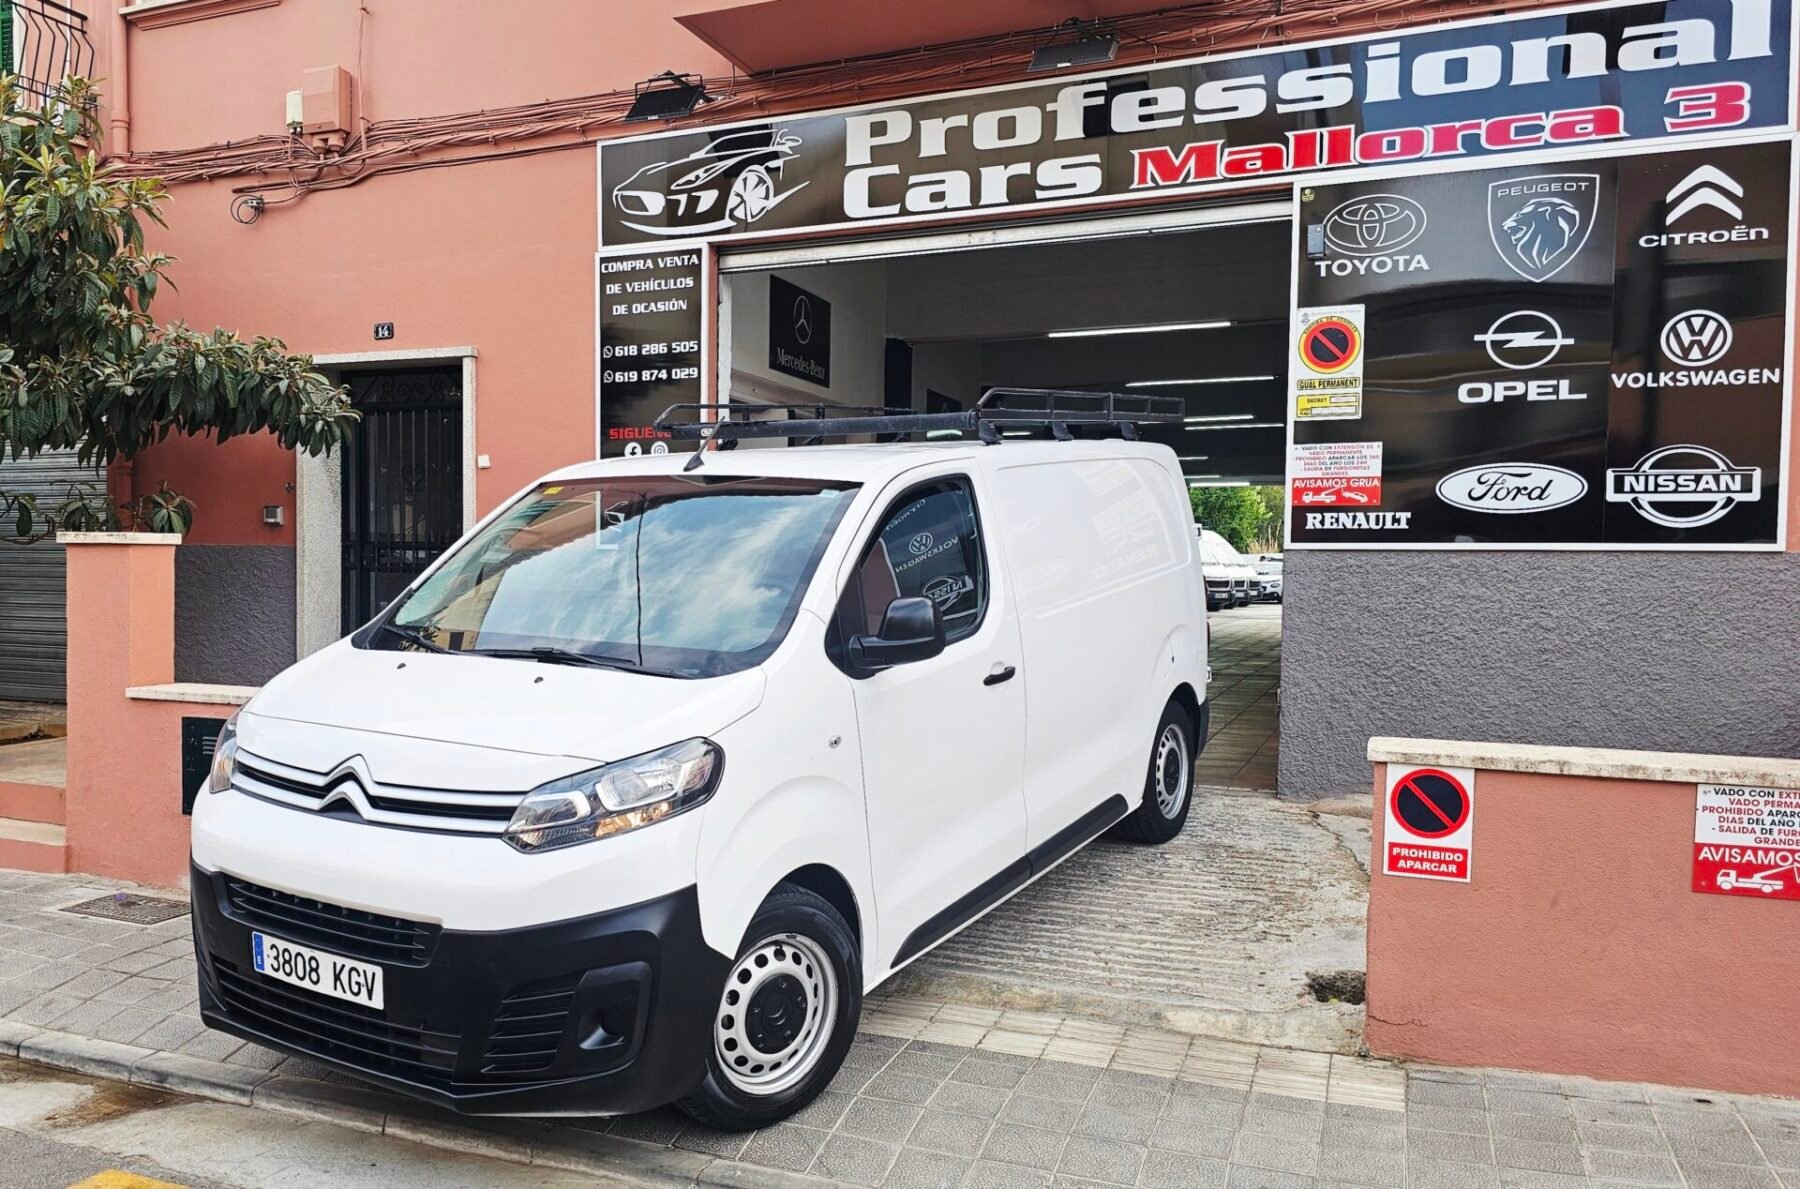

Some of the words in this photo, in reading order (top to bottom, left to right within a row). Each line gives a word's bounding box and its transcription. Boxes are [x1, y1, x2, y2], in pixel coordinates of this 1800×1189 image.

[845, 0, 1773, 166] Professional
[843, 153, 1102, 219] Cars
[1129, 104, 1631, 189] Mallorca
[1663, 81, 1752, 133] 3
[1497, 181, 1590, 198] PEUGEOT
[1638, 224, 1768, 248] CITROËN
[601, 258, 654, 273] COMPRA
[657, 254, 699, 269] VENTA
[1315, 255, 1430, 278] TOYOTA
[605, 281, 622, 295] DE
[625, 276, 694, 293] VEHÍCULOS
[612, 303, 629, 315] DE
[632, 298, 688, 314] OCASIÓN
[614, 345, 638, 357] 618
[641, 343, 668, 355] 286
[671, 341, 698, 353] 505
[777, 346, 825, 379] Mercedes-Benz
[614, 371, 638, 383] 619
[641, 369, 668, 381] 874
[671, 367, 698, 380] 029
[1318, 379, 1357, 388] PERMANENT
[1611, 368, 1780, 389] VOLKSWAGEN
[1457, 379, 1587, 404] OPEL
[609, 426, 672, 439] SIGUE
[1293, 479, 1347, 488] AVISAMOS
[1350, 478, 1380, 487] GRUA
[1467, 471, 1552, 502] Ford
[1622, 473, 1742, 493] NISSAN
[1305, 511, 1411, 530] RENAULT
[1713, 788, 1745, 797] VADO
[1749, 789, 1775, 798] CON
[1778, 791, 1800, 800] EXT
[1729, 798, 1760, 807] VADO
[1701, 805, 1764, 817] PROHIBIDO
[1718, 815, 1744, 824] DIAS
[1747, 817, 1766, 826] DEL
[1718, 825, 1757, 834] SALIDA
[1760, 828, 1774, 836] DE
[1392, 847, 1464, 862] PROHIBIDO
[1397, 859, 1457, 873] APARCAR
[269, 943, 320, 986] 3808
[333, 960, 376, 1002] KGV
